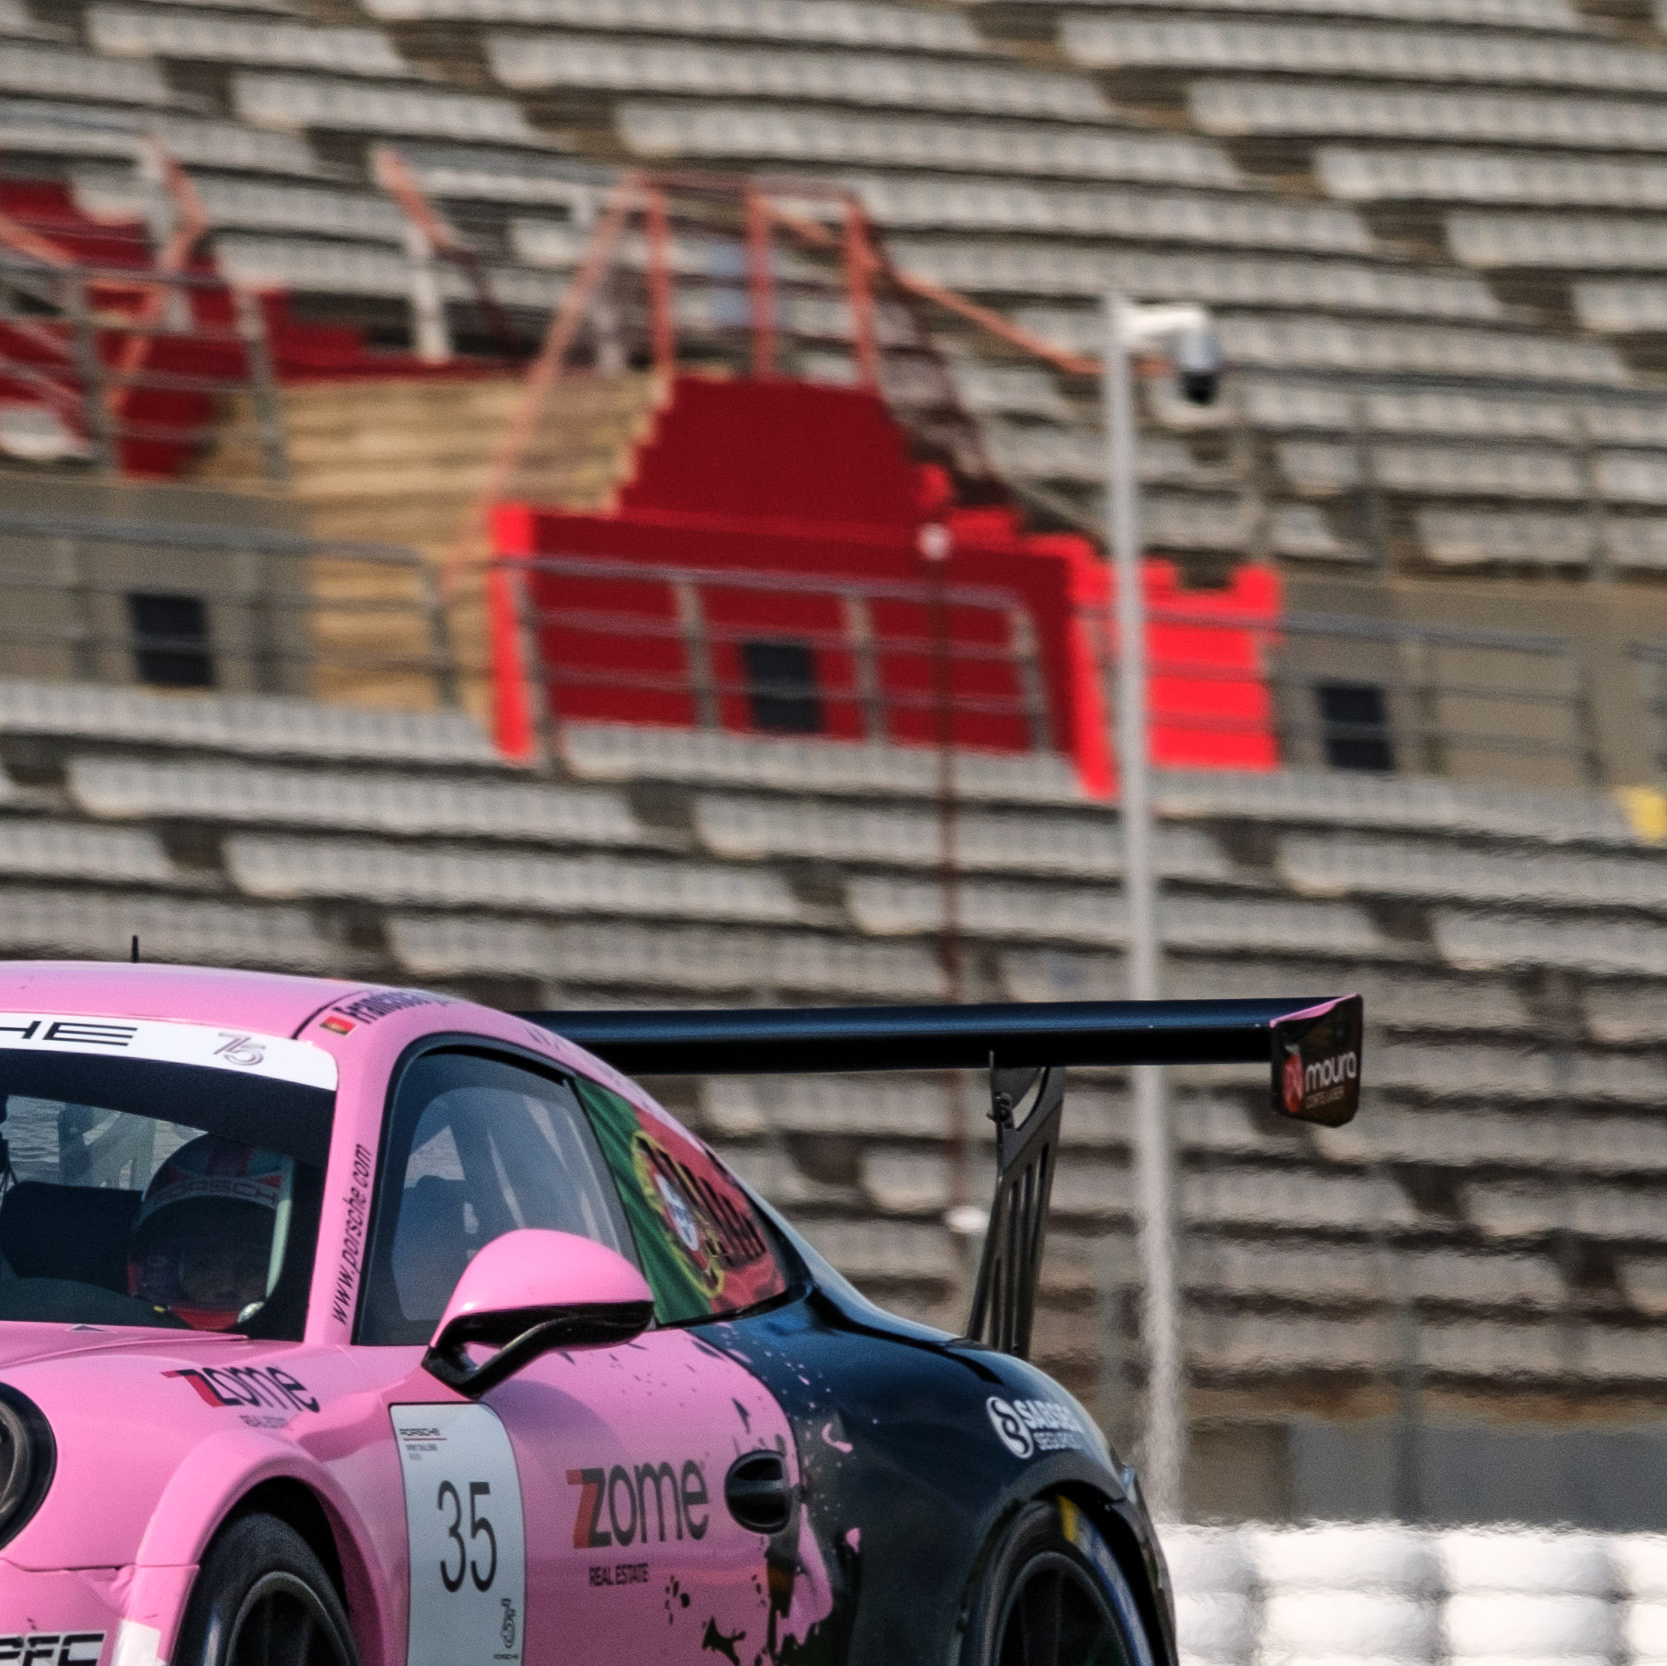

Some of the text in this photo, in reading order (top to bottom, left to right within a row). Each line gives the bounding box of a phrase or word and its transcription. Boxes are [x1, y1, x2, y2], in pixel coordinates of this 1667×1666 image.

[1305, 1051, 1357, 1093] moura
[332, 1143, 373, 1326] www.porsche.com
[160, 1366, 320, 1413] zome
[436, 1480, 498, 1593] 35
[567, 1458, 709, 1549] zome
[588, 1563, 649, 1587] REAL ESTATE
